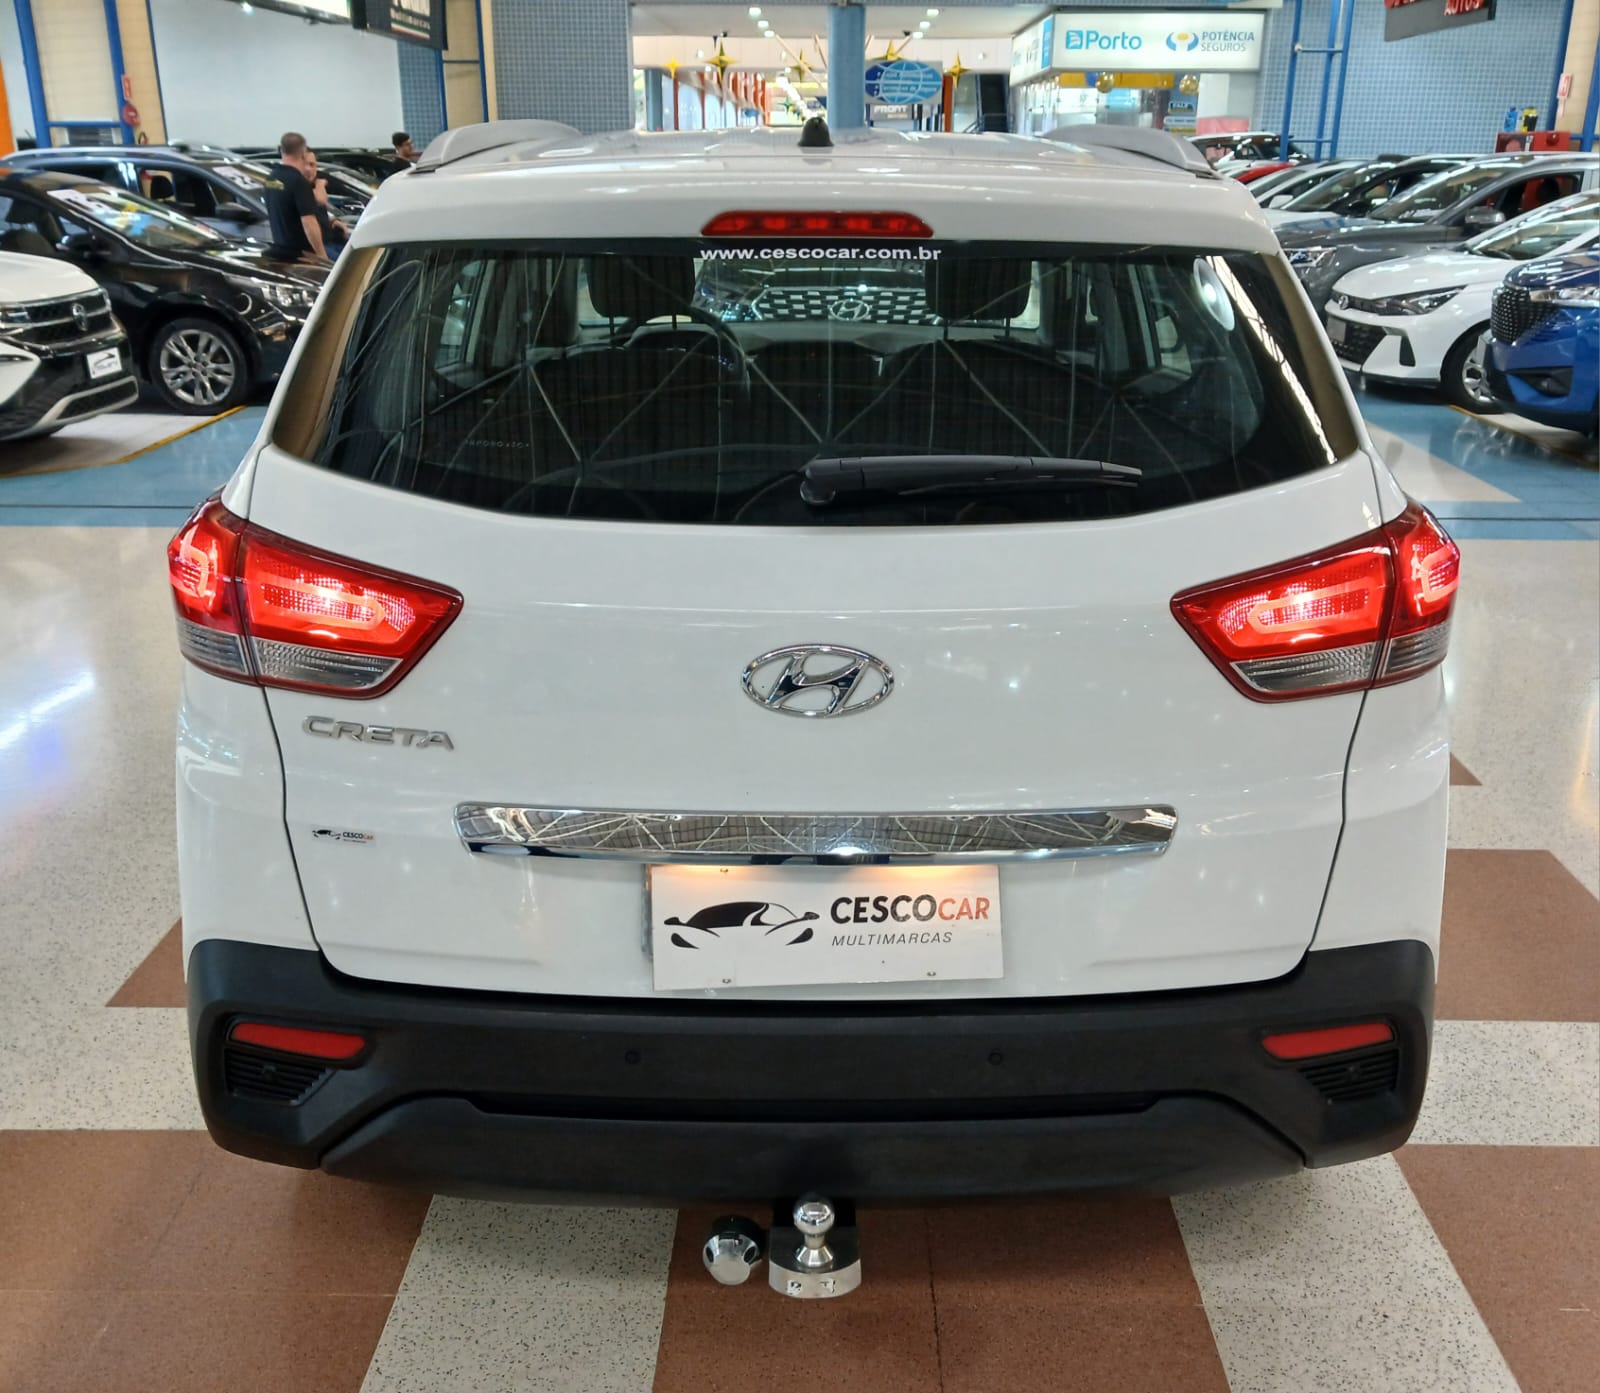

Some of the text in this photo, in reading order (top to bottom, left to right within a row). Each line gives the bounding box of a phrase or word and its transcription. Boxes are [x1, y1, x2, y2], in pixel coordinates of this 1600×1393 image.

[1085, 30, 1142, 50] Porto
[1202, 29, 1255, 42] POTÊNCIA
[1201, 42, 1247, 52] SEGUROS
[700, 246, 942, 261] www.cescocar.com.br
[302, 715, 455, 750] CRETA
[830, 894, 991, 924] CESCOCAR
[832, 932, 953, 946] MULTIMARCAS
